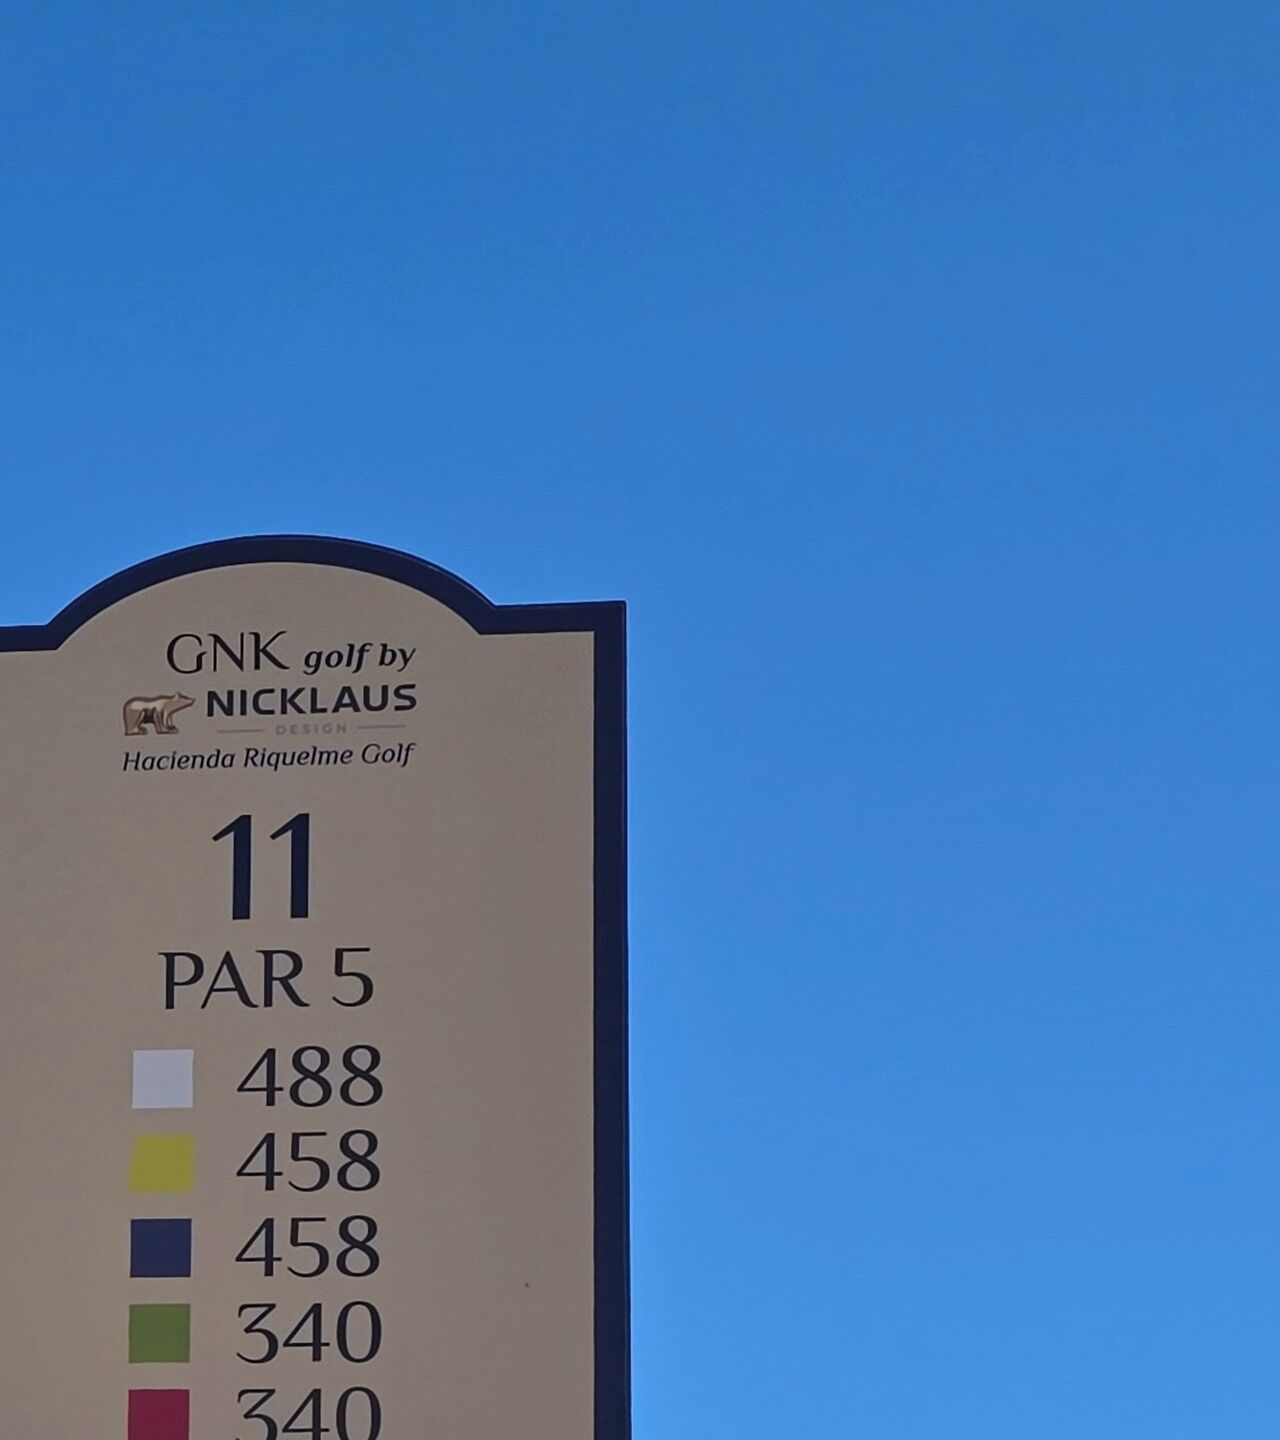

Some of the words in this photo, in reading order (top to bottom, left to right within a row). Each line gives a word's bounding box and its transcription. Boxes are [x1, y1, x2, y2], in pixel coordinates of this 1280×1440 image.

[166, 631, 290, 675] GNK
[303, 642, 374, 676] golf
[378, 643, 417, 673] by
[206, 683, 418, 718] NICKLAUS
[275, 722, 348, 736] DESIGN
[122, 748, 236, 772] Hacienda
[243, 746, 354, 772] Riquelme
[361, 743, 417, 769] Golf
[211, 812, 310, 921] 11
[157, 949, 311, 1010] PAR
[331, 947, 375, 1008] 5
[236, 1044, 384, 1108] 488
[235, 1129, 381, 1193] 458
[234, 1214, 381, 1278] 458
[235, 1300, 383, 1364] 340
